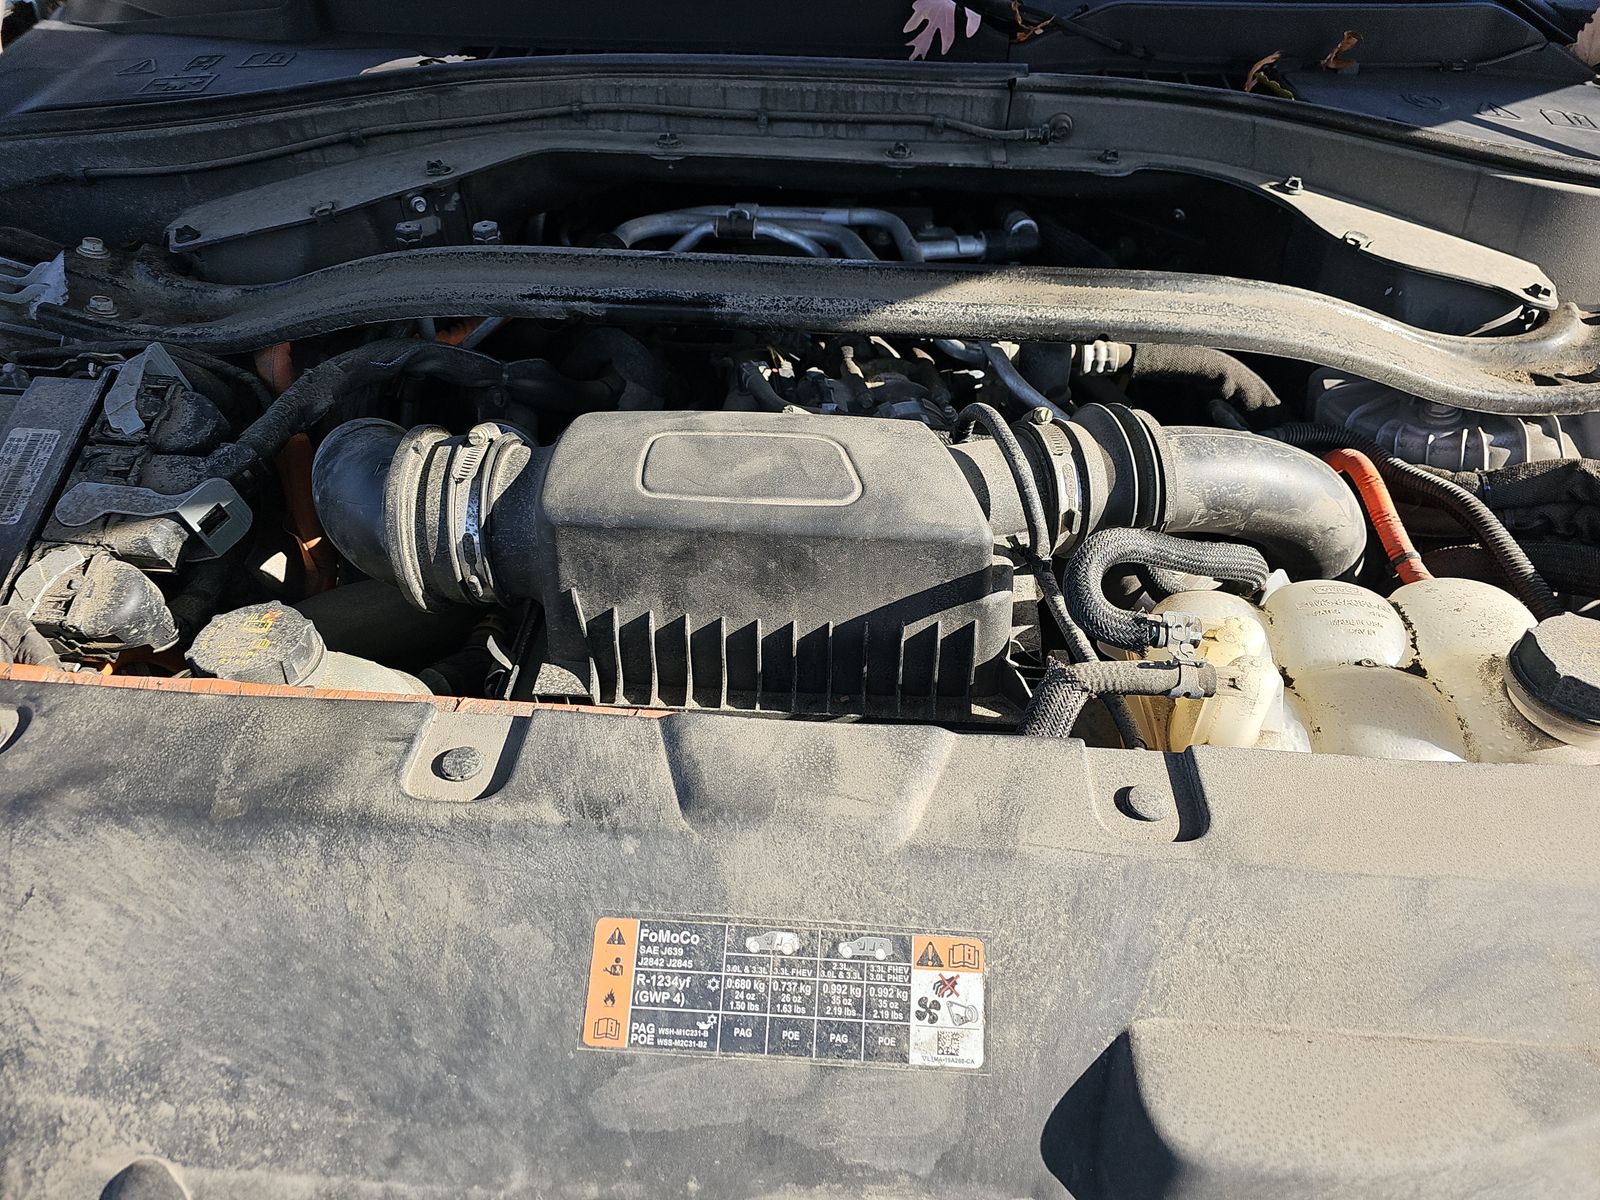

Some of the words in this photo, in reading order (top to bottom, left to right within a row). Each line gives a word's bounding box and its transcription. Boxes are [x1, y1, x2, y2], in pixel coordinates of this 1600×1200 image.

[640, 928, 700, 945] FoMoCo
[639, 945, 660, 955] SAE
[661, 947, 684, 956] J639
[638, 957, 664, 967] J2842
[666, 959, 693, 969] J2845
[743, 966, 749, 974] &
[751, 966, 768, 975] 3.3L
[773, 967, 790, 976] 3.3L
[791, 968, 813, 977] FHEV
[820, 969, 837, 979] 3.0L
[846, 972, 863, 981] 3.3L
[869, 964, 886, 974] 3.3L
[887, 965, 910, 975] FHEV
[636, 973, 692, 990] R-1234yf
[869, 972, 886, 982] 3.0L
[887, 973, 910, 983] PHEV
[726, 978, 752, 990] 0.680
[753, 980, 766, 992] kg
[772, 981, 798, 993] 0.737
[799, 984, 812, 996] kg
[734, 990, 745, 1001] 24
[745, 991, 756, 1001] oz
[822, 983, 848, 996] 0.992
[849, 986, 862, 999] kg
[869, 986, 896, 999] 0.992
[896, 988, 909, 1002] kg
[634, 990, 671, 1005] (GWP
[672, 992, 685, 1007] 4)
[780, 993, 792, 1003] 26
[792, 995, 803, 1004] oz
[831, 995, 842, 1006] 35
[842, 998, 853, 1006] oz
[878, 999, 889, 1009] 35
[889, 1001, 900, 1009] oz
[729, 1000, 746, 1011] 1.50
[747, 1002, 760, 1012] lbs
[776, 1003, 793, 1014] 1.63
[794, 1005, 807, 1015] lbs
[825, 1006, 843, 1016] 2.19
[844, 1007, 857, 1017] lbs
[872, 1009, 890, 1019] 2.19
[891, 1010, 904, 1021] lbs
[631, 1022, 656, 1034] PAG
[733, 1027, 753, 1038] PAG
[630, 1034, 655, 1046] POE
[782, 1030, 801, 1041] POE
[829, 1033, 849, 1044] PAG
[878, 1036, 897, 1047] POE
